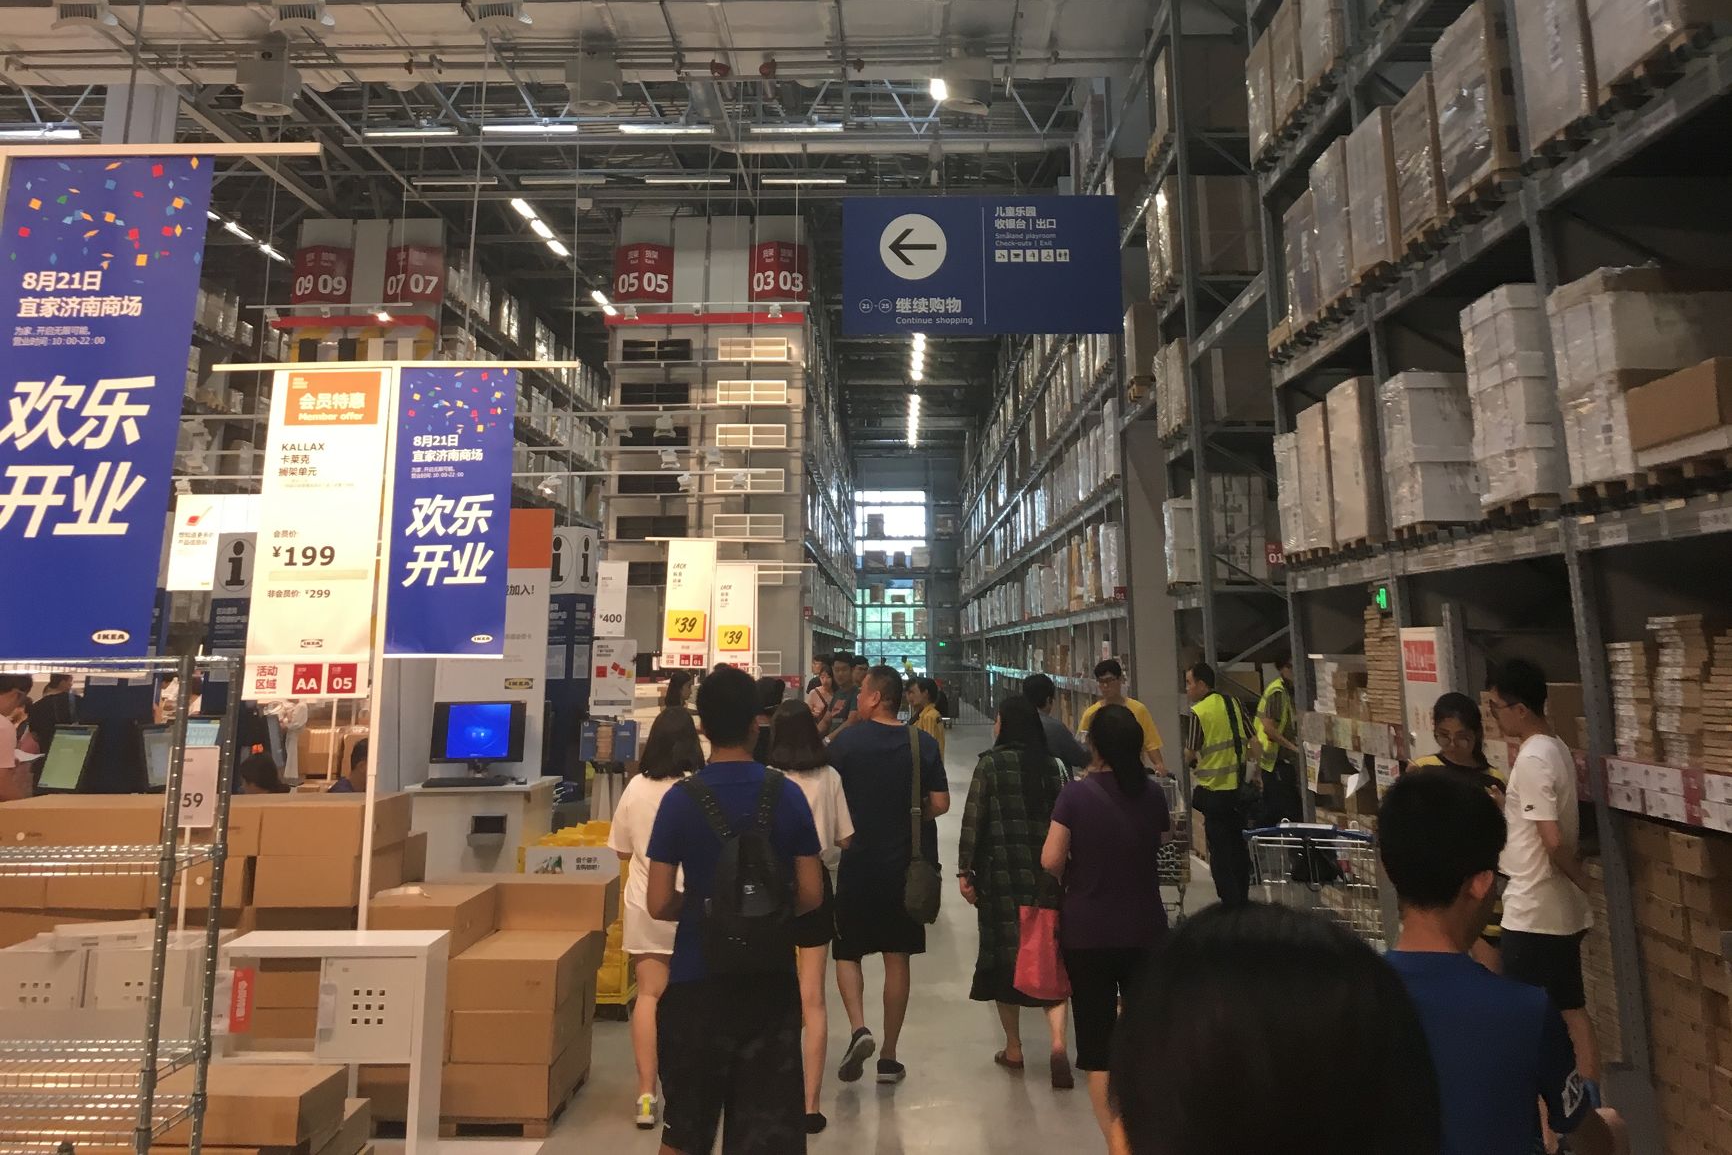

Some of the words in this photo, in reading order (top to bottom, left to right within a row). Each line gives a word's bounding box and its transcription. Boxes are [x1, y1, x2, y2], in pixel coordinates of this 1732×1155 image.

[1035, 218, 1056, 229] 出口
[22, 271, 102, 291] 8月21日
[295, 274, 314, 296] 09
[318, 274, 347, 296] 09
[387, 274, 406, 295] 07
[409, 273, 439, 295] 07
[618, 272, 639, 294] 05
[643, 272, 669, 294] 05
[753, 270, 775, 292] 03
[778, 271, 804, 292] 03
[17, 296, 143, 318] 宜家济南商场
[895, 297, 962, 314] 继续购物
[895, 316, 933, 324] Continue
[935, 316, 973, 326] shopping
[0, 375, 156, 451] 欢乐
[298, 412, 338, 421] Member
[339, 412, 365, 421] offer
[281, 443, 325, 452] KALLAX
[412, 434, 459, 447] 8月21日
[281, 454, 311, 465] 卡莱克
[411, 449, 484, 463] 宜家济南商场
[0, 461, 147, 538] 开业
[405, 493, 495, 538] 欢乐
[272, 545, 336, 567] ¥199
[402, 542, 495, 587] 开业
[1268, 552, 1285, 564] 01
[95, 632, 127, 642] IKEA
[256, 664, 278, 677] 活动
[255, 679, 277, 690] 区域
[295, 678, 318, 690] AA
[332, 677, 353, 690] 05
[506, 679, 532, 688] IKEA
